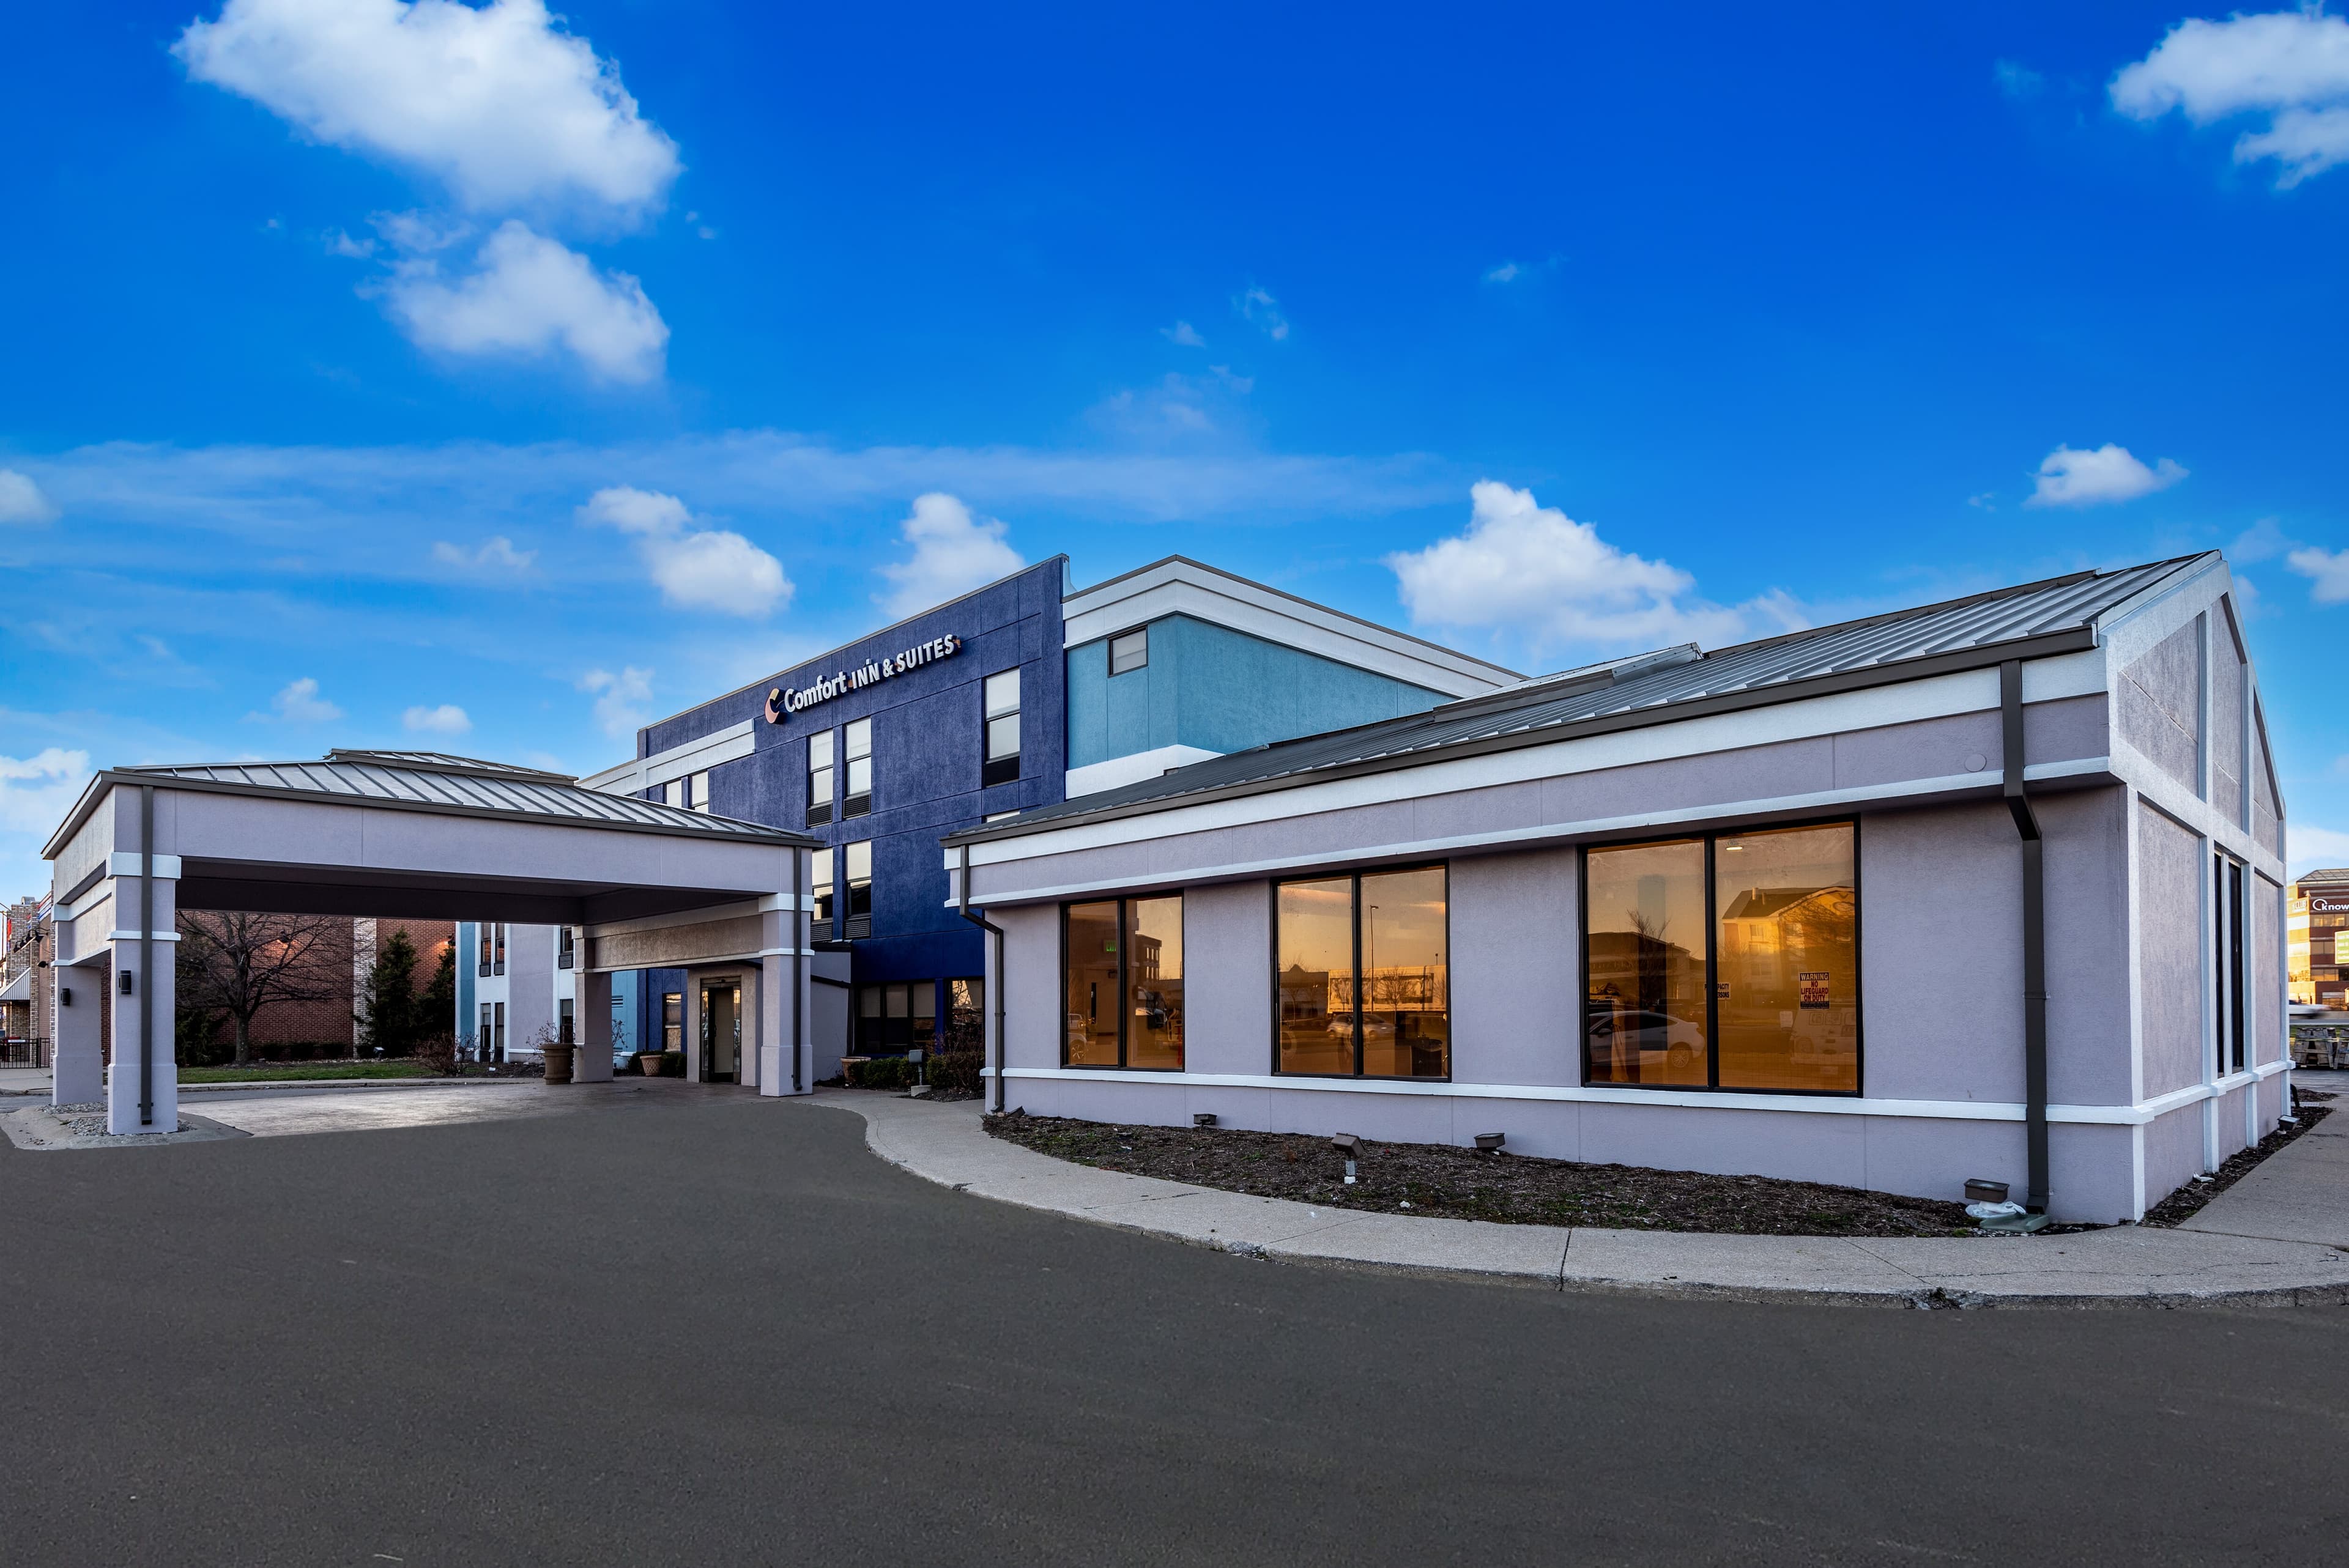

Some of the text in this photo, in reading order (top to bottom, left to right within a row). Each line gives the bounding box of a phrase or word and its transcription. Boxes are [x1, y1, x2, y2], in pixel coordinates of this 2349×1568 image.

[784, 634, 954, 712] Comfort INN & SUITES
